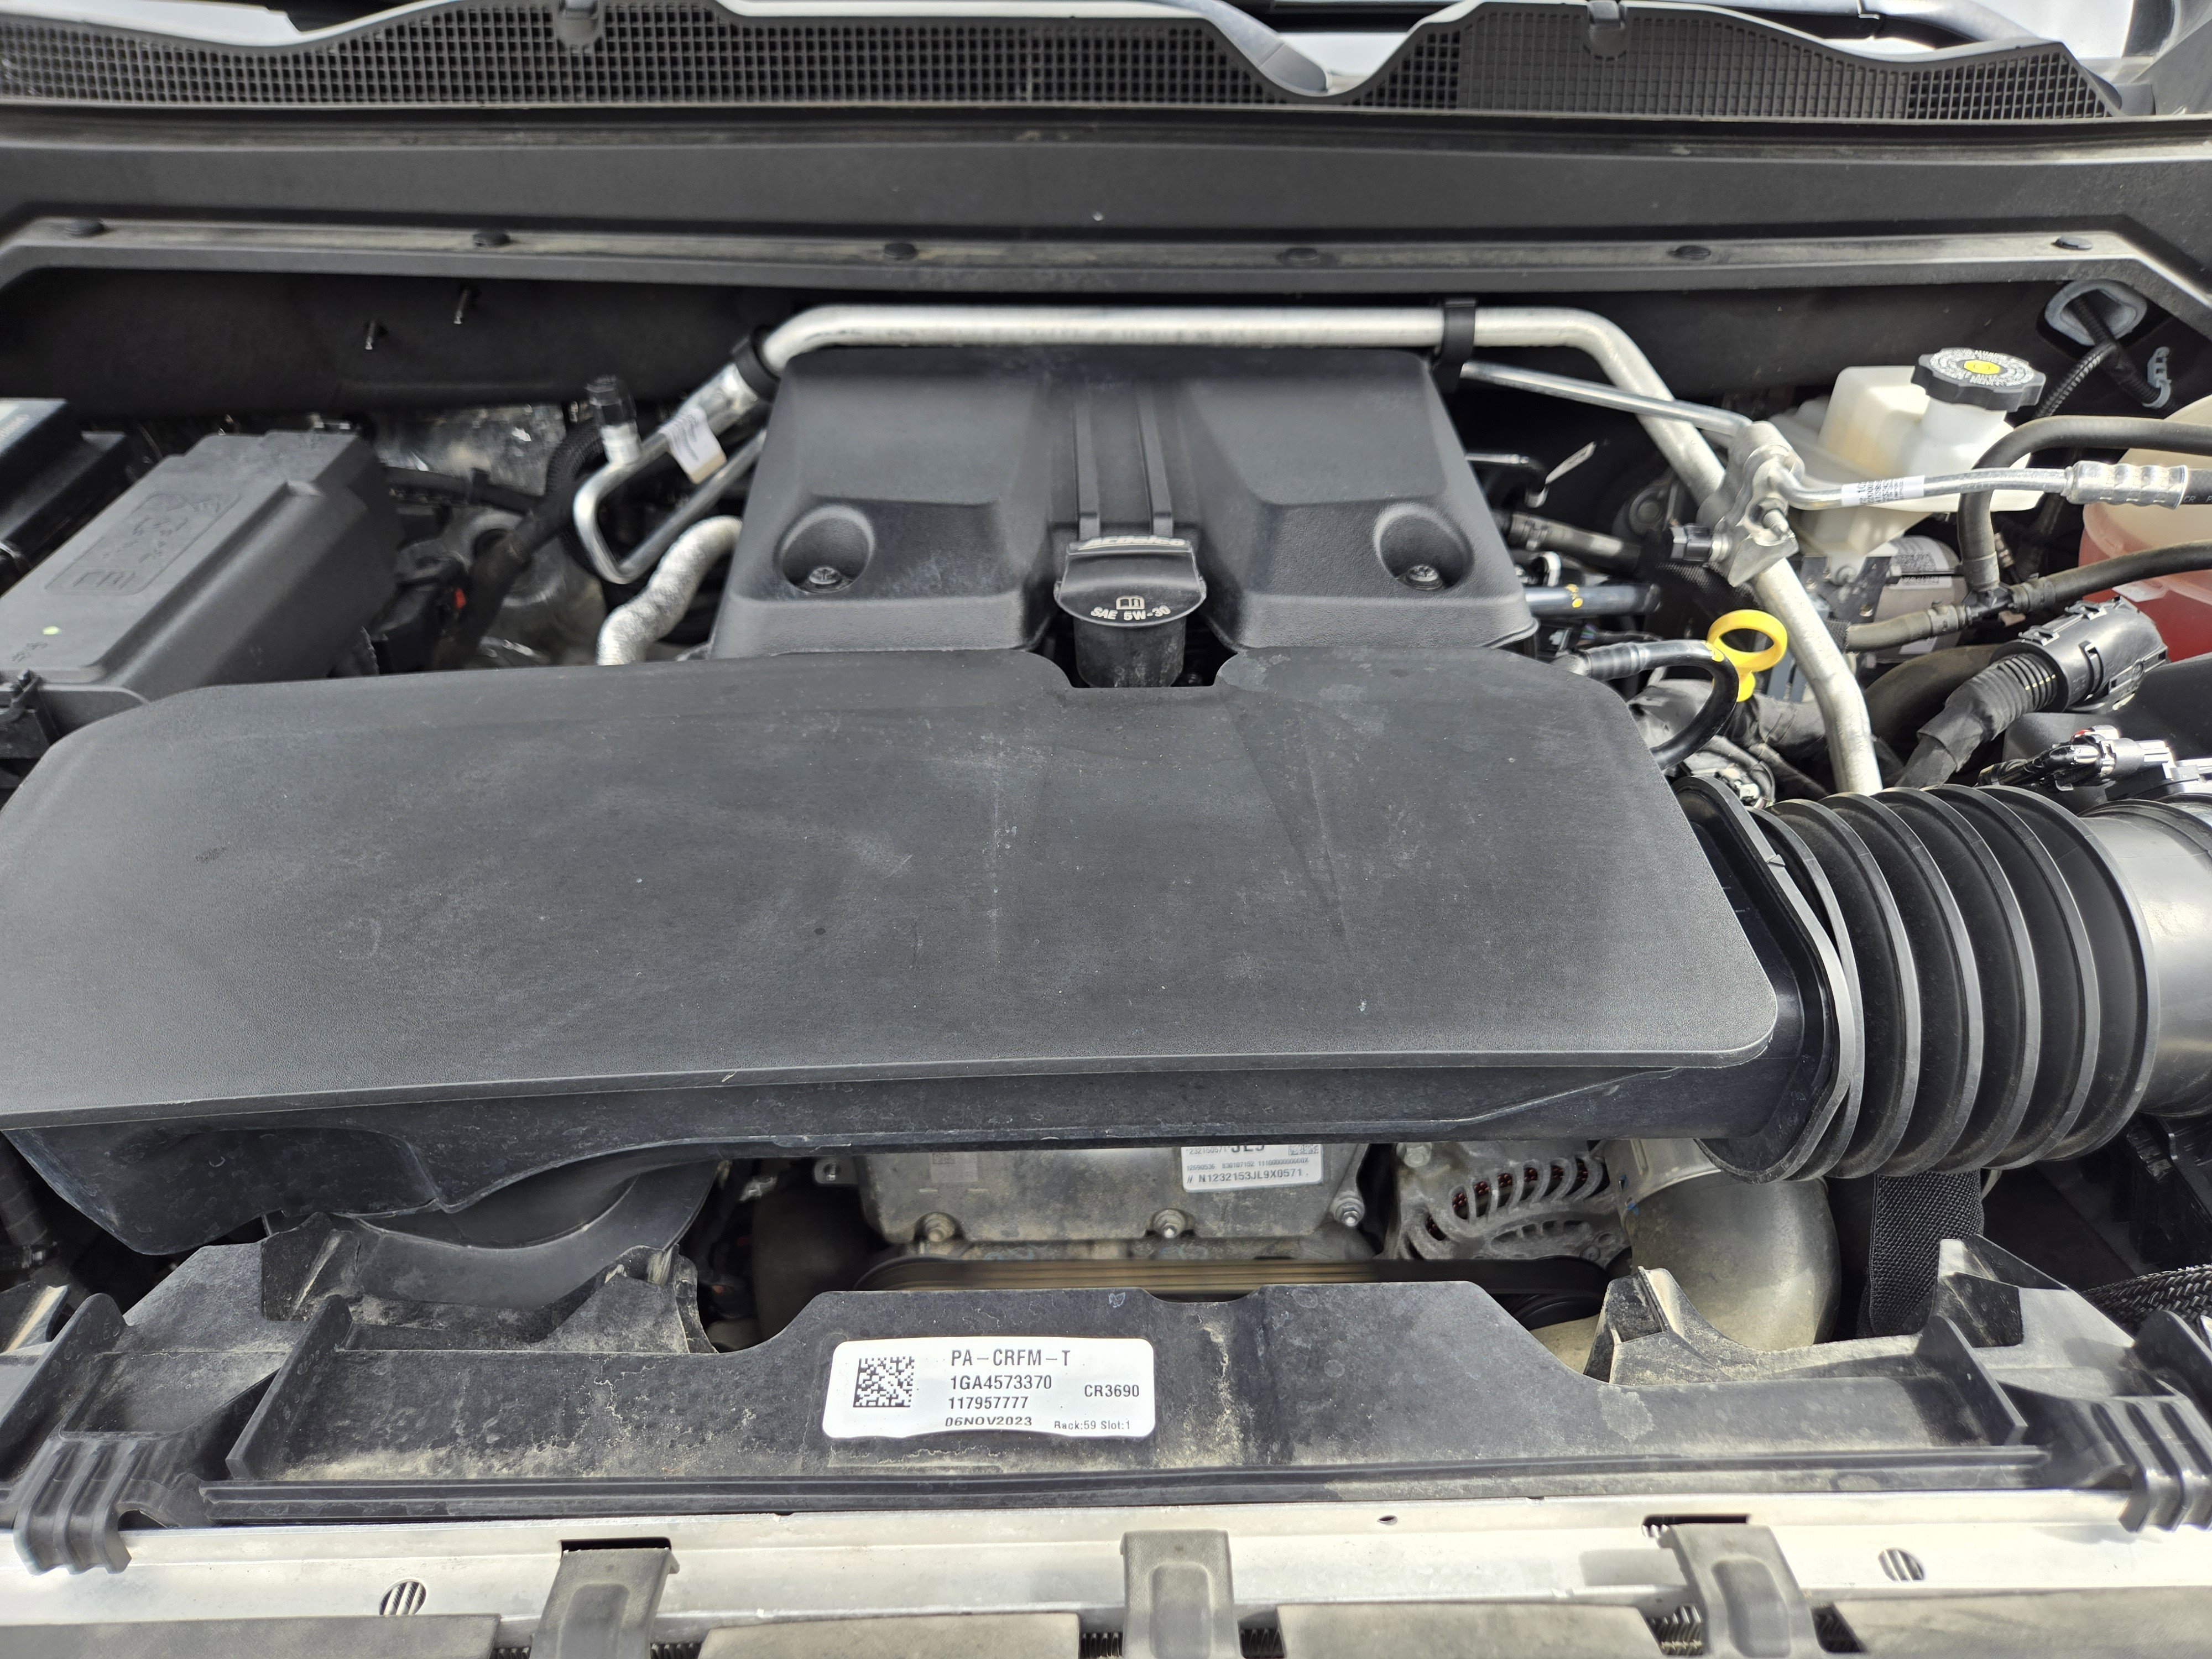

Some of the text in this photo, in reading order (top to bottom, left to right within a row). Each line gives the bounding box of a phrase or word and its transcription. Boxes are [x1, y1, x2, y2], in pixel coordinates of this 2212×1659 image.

[1082, 536, 1186, 547] ACDelco
[1091, 605, 1171, 620] SAE 5W-30
[950, 1374, 1052, 1390] 1GA4573370
[1084, 1384, 1139, 1397] CR3690
[948, 1396, 1029, 1410] 117957777
[945, 1416, 1032, 1427] 06NOV2023
[1054, 1420, 1130, 1430] Rack:59 Slot:1
